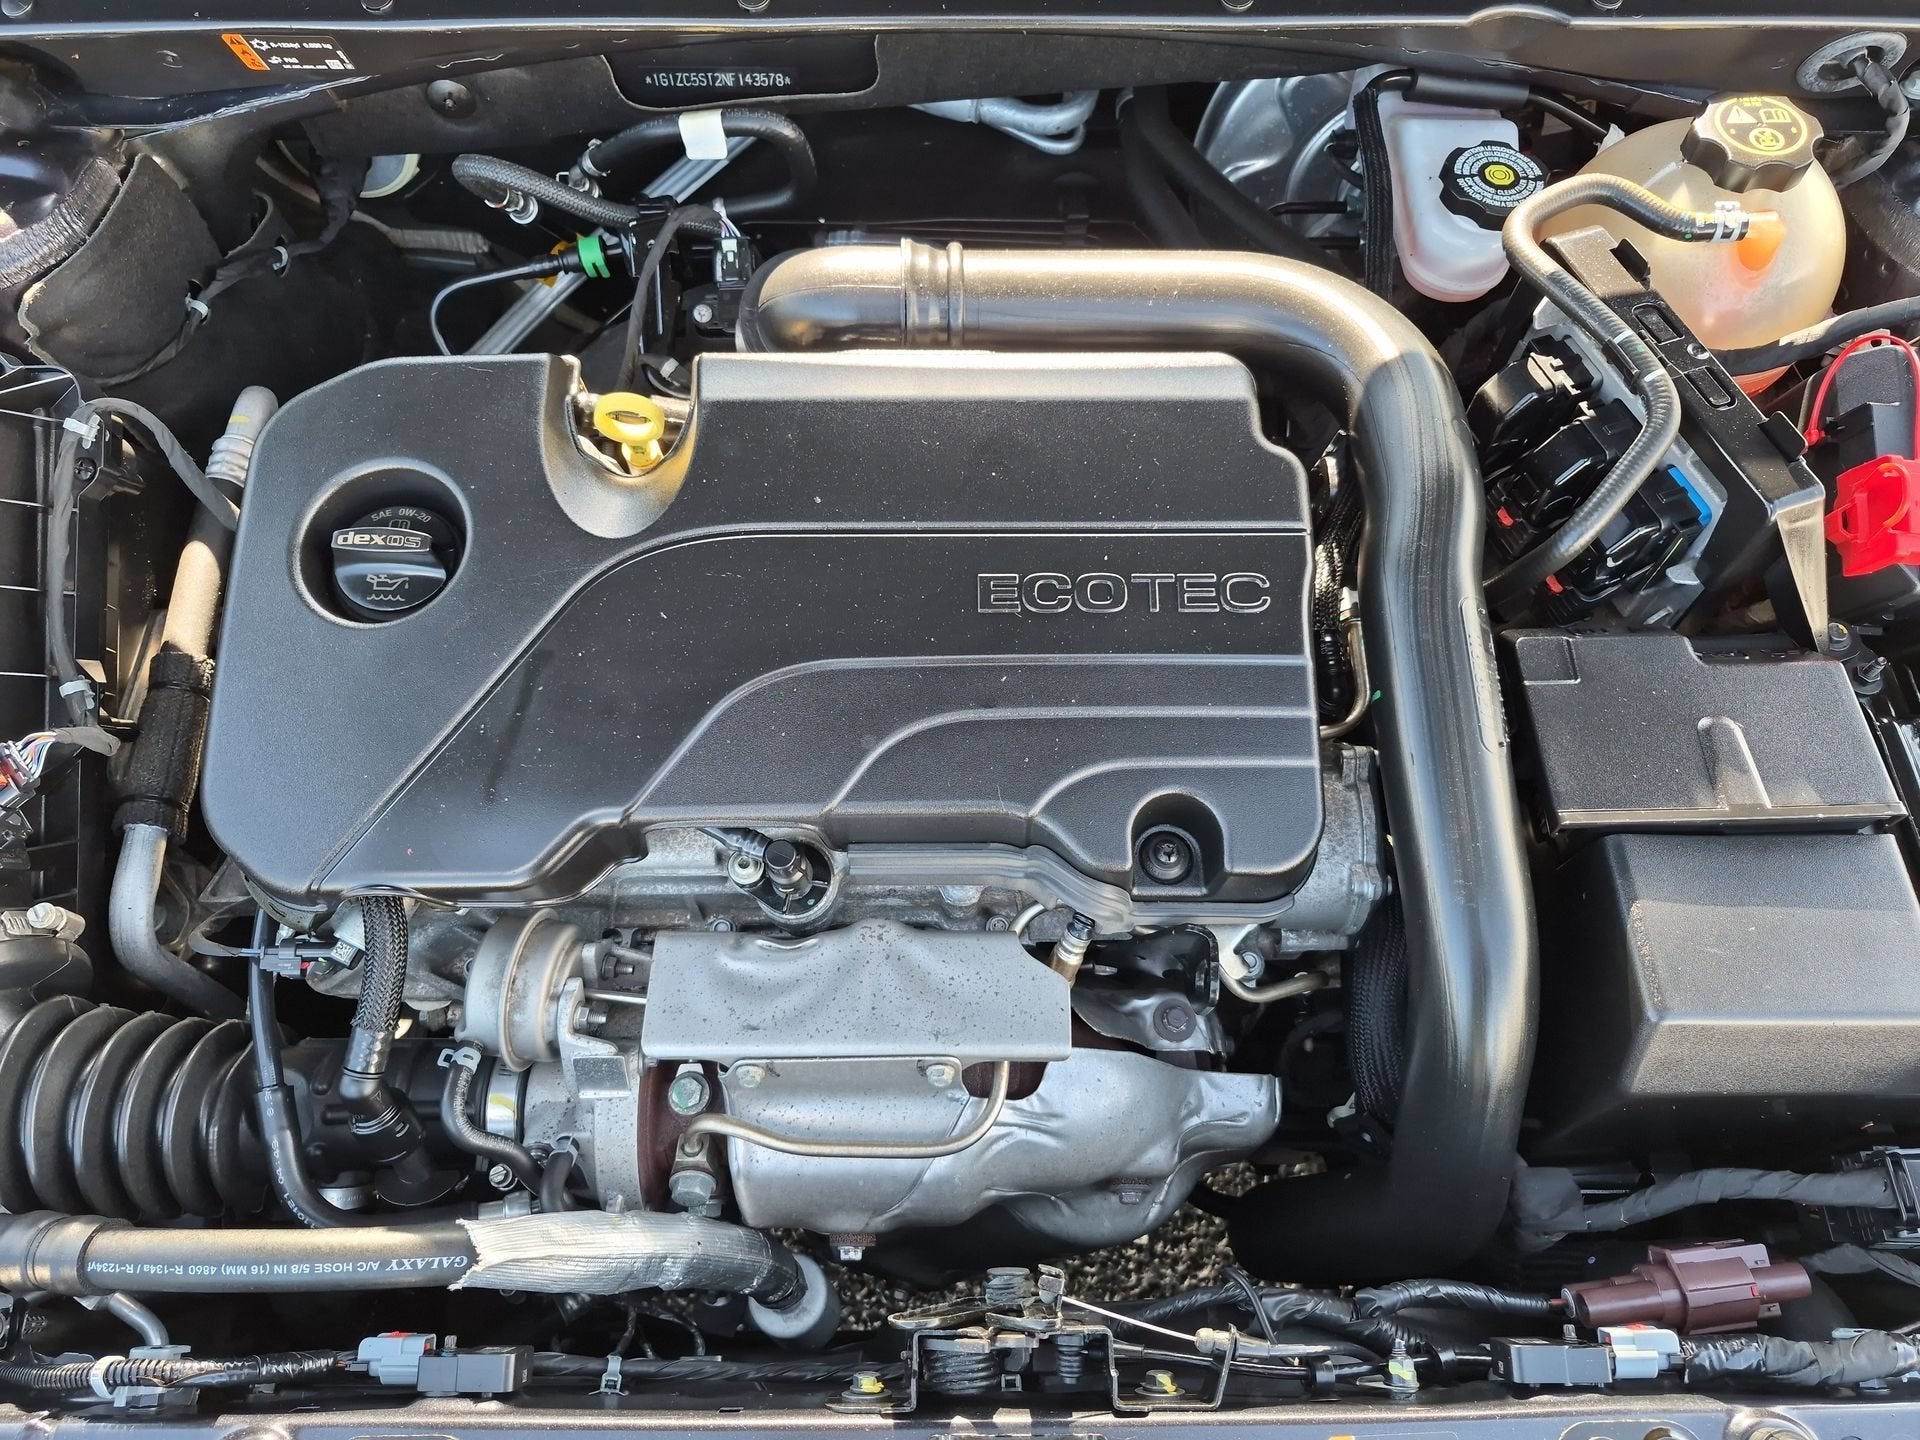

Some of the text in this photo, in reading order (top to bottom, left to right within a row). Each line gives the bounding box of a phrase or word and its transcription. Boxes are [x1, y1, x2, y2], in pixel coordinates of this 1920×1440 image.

[371, 508, 432, 523] SAE 0W-20
[337, 532, 422, 548] dexos
[977, 572, 1271, 613] ECOTEC
[87, 1255, 468, 1276] GALAXY A/C HOSE 5/8 IN (16 MM) 4860 R-134a / R-1234yf
